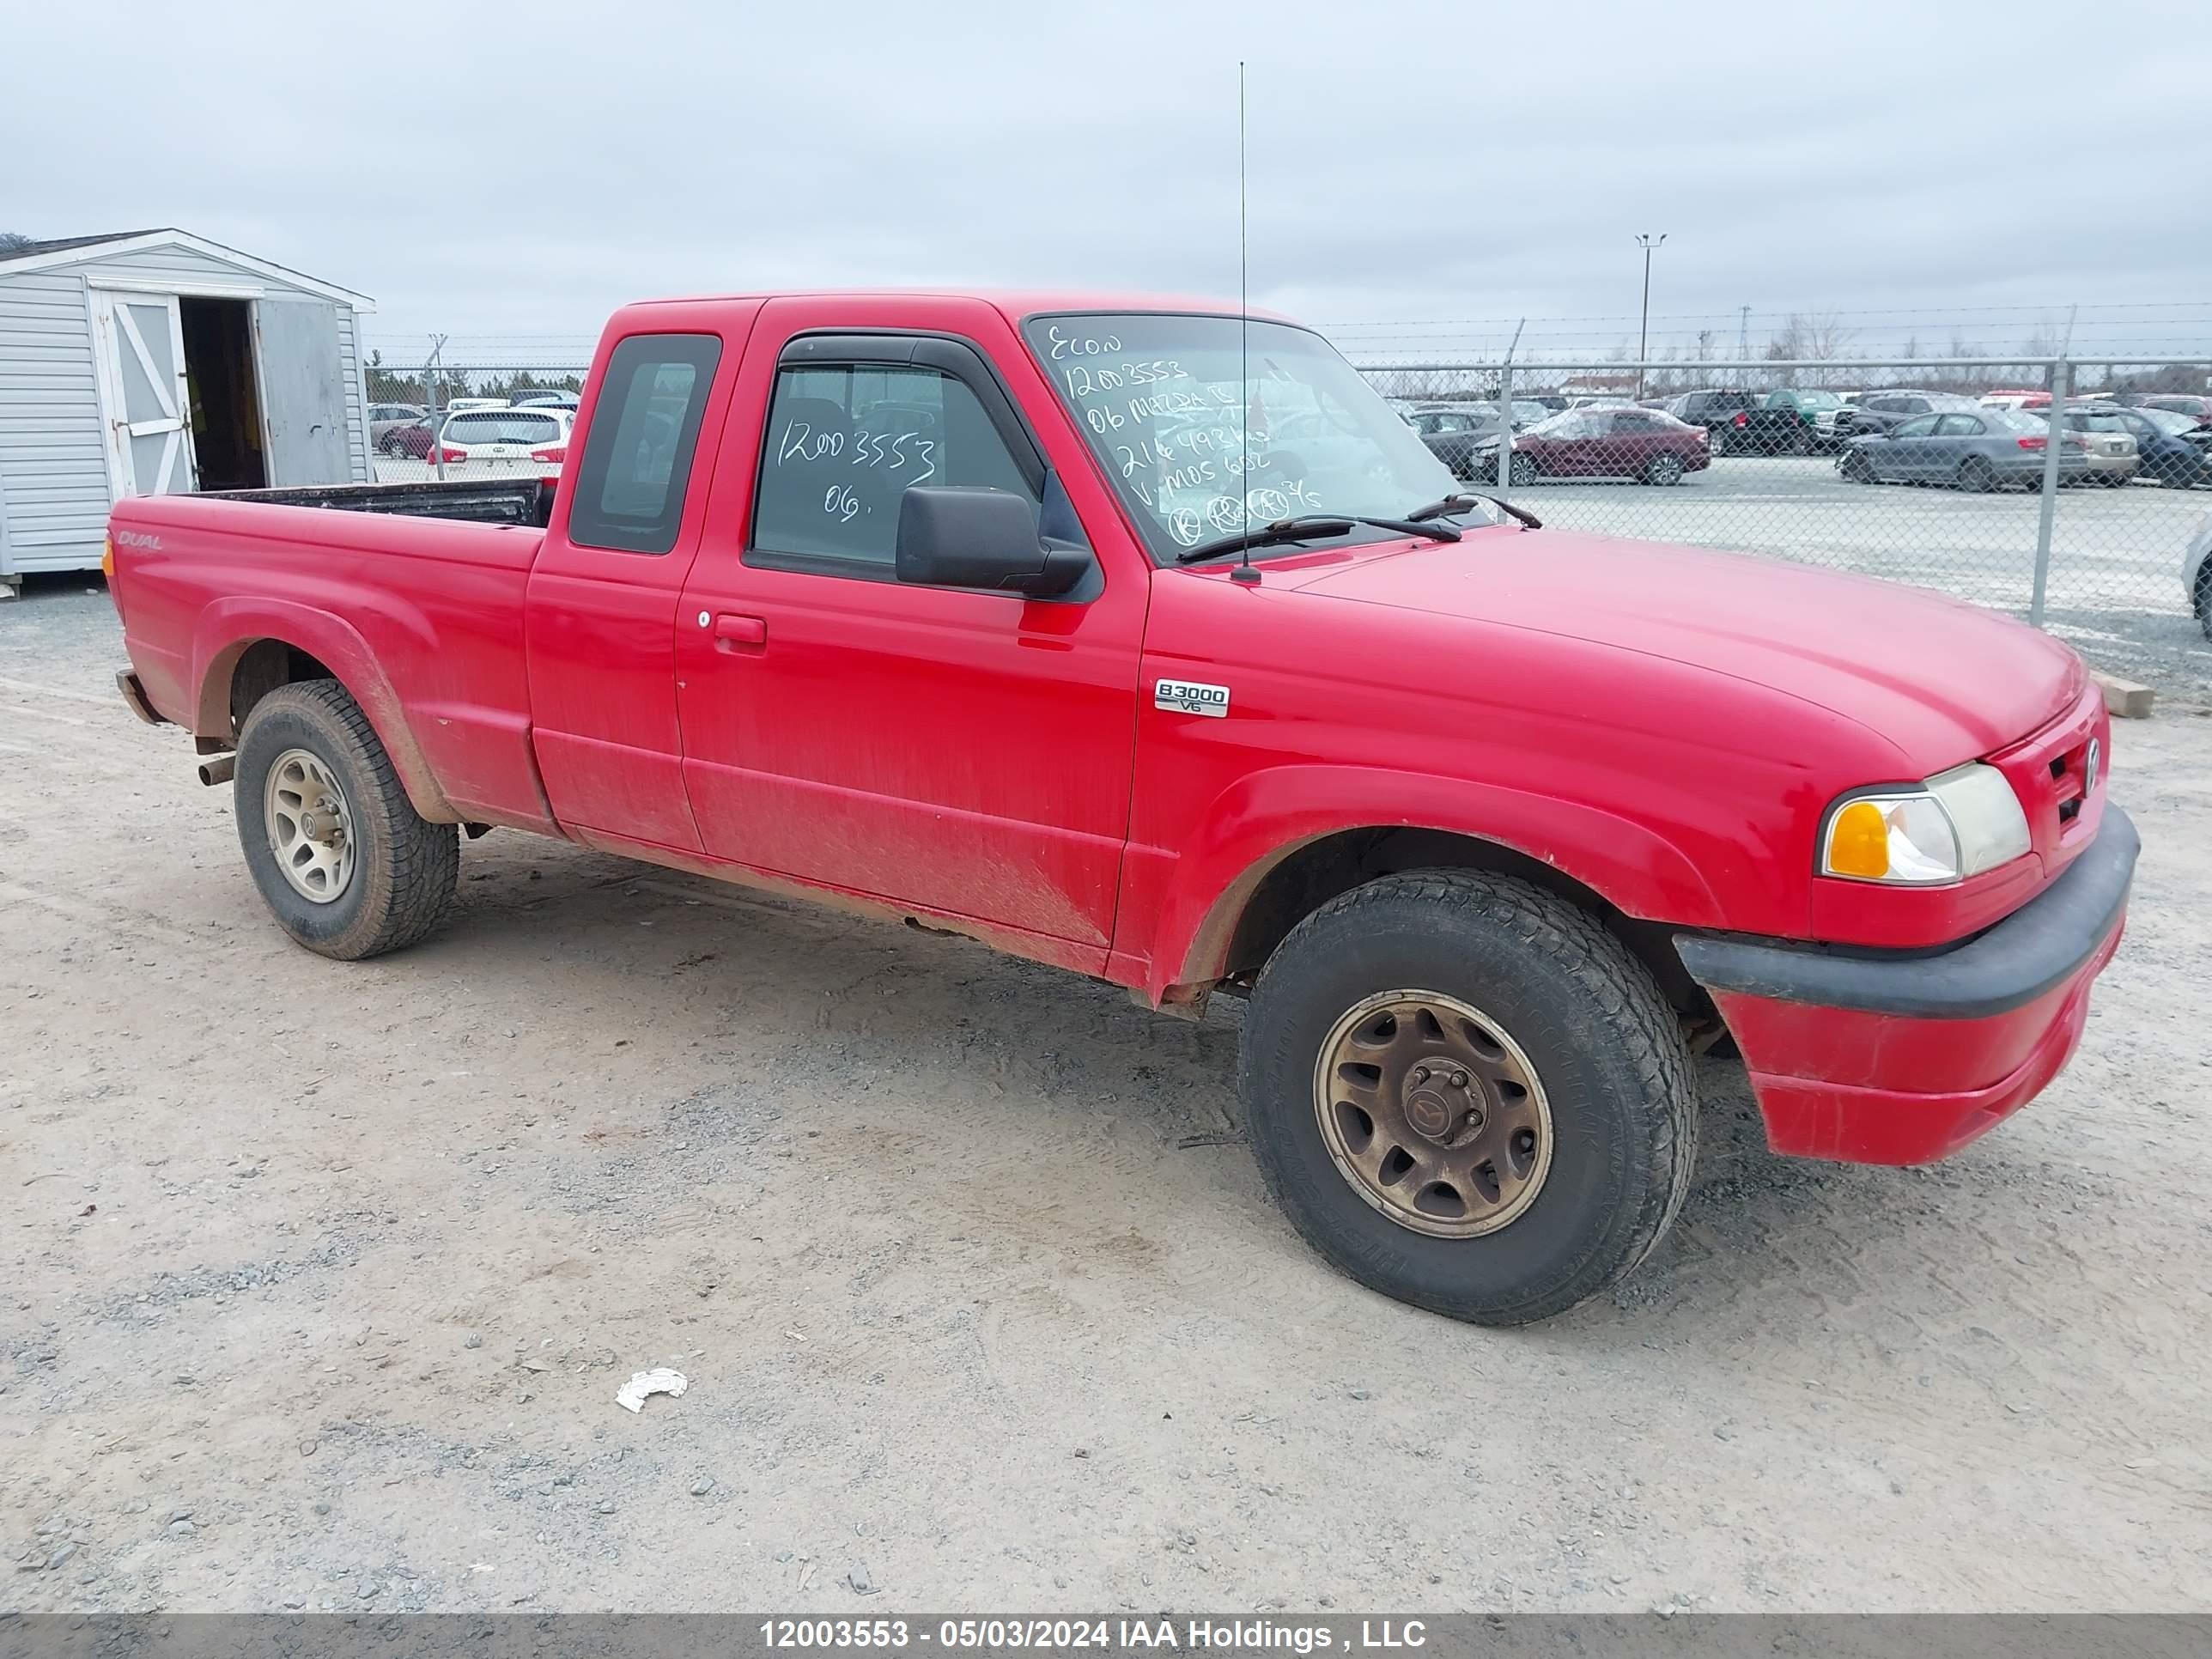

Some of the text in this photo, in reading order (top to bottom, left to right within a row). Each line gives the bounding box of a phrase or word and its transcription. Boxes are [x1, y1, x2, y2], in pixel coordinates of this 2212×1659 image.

[1066, 361, 1189, 400] 12003553
[1086, 404, 1125, 434] 06
[118, 530, 164, 550] DUAL
[1158, 684, 1225, 703] B3000
[1179, 700, 1202, 713] V6
